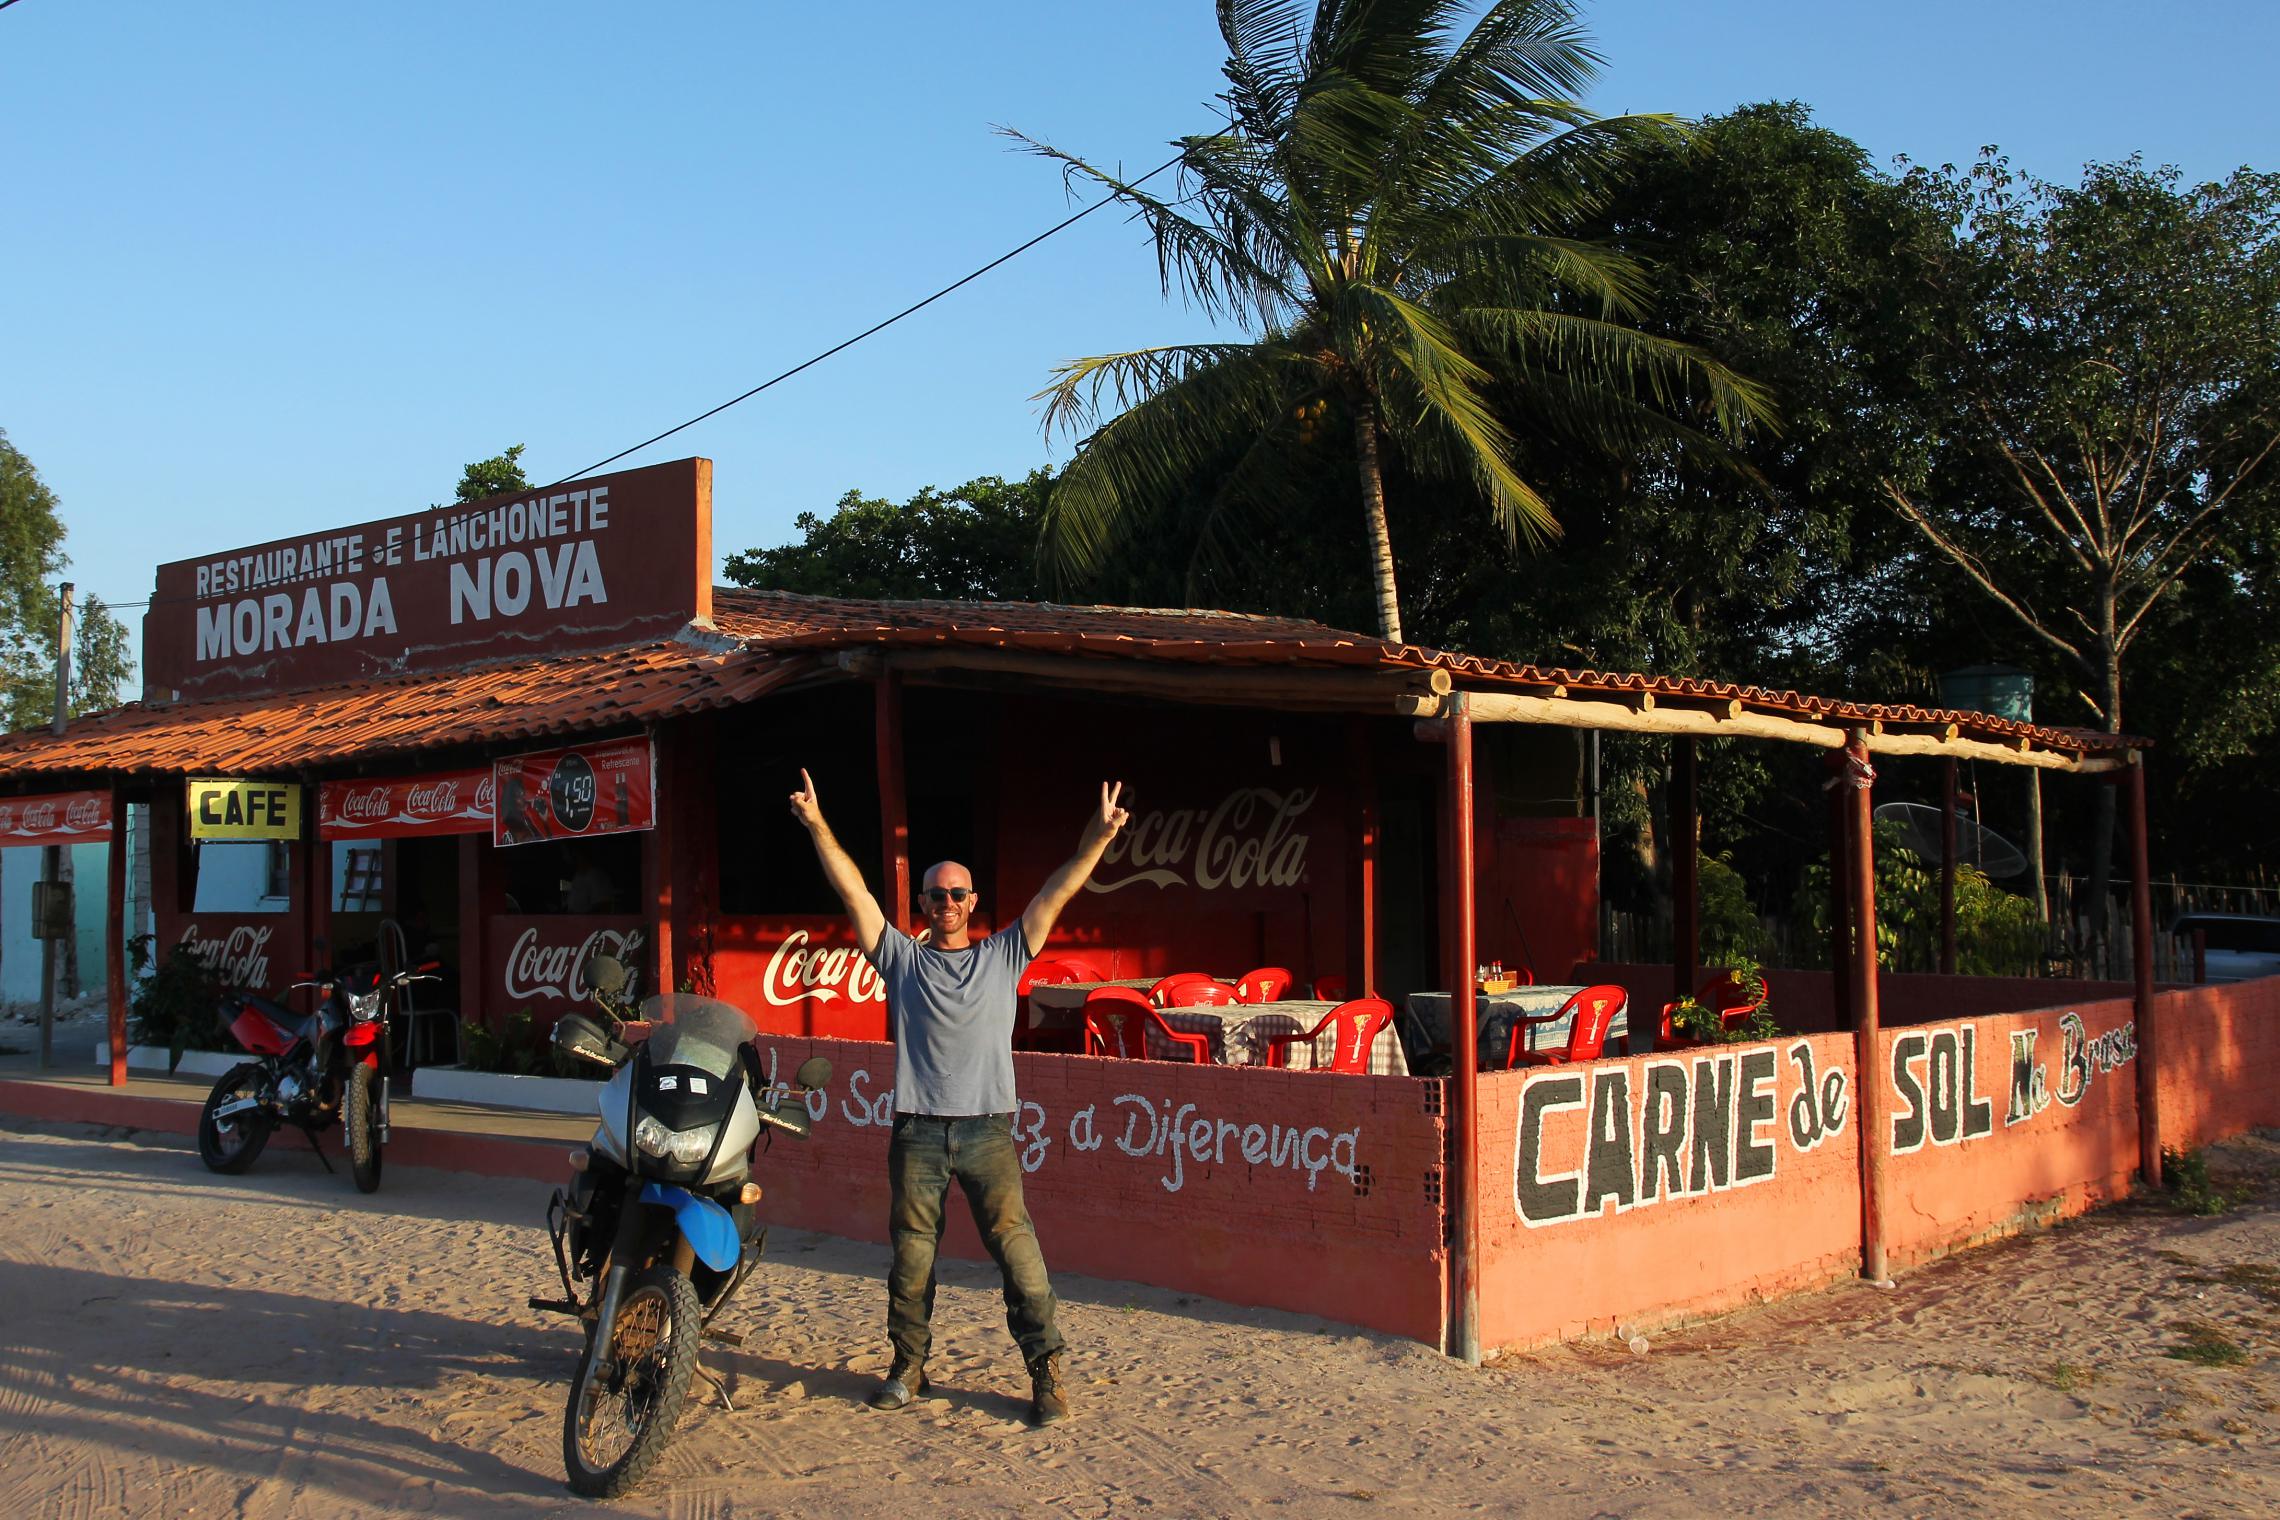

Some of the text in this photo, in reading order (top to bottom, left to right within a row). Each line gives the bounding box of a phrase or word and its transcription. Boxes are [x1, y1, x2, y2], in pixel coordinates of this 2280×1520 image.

[197, 486, 609, 600] RESTAURANTE E LANCHONETE
[197, 539, 608, 661] MORADA NOVA
[65, 799, 101, 826] Coca-Cola
[200, 790, 288, 826] CAFE
[343, 785, 391, 818] Coca-Cola
[407, 781, 460, 814] Coca-Cola
[1070, 1104, 1102, 1150] a
[1114, 1094, 1360, 1192] Diferença
[1514, 1046, 1777, 1229] CARNE
[1787, 1039, 1849, 1151] de
[1890, 1024, 1992, 1156] SOL
[2004, 1028, 2050, 1127] Na
